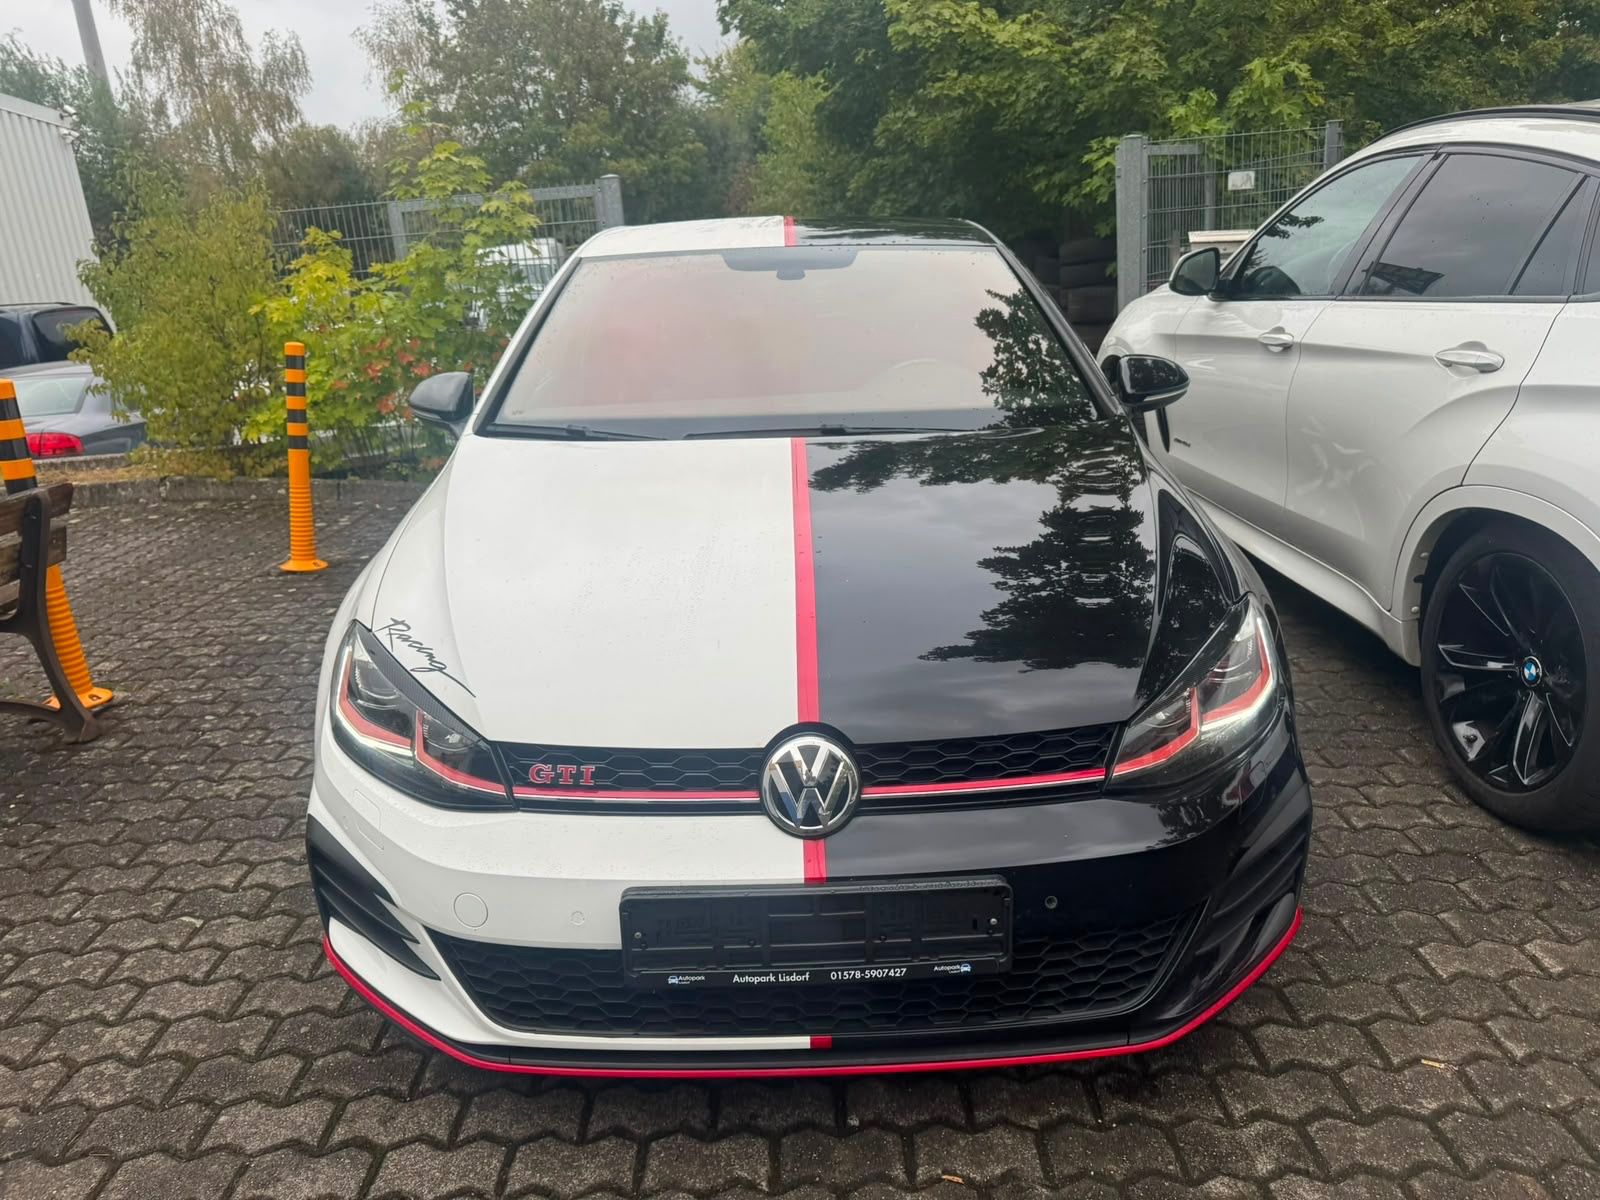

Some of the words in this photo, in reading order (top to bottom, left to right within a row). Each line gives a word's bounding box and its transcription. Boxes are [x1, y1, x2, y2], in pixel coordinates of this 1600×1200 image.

[528, 763, 596, 786] GTI
[766, 739, 855, 832] VW
[732, 972, 776, 985] Autopark
[778, 971, 810, 983] Lisdorf
[830, 967, 907, 980] 01578-5907427
